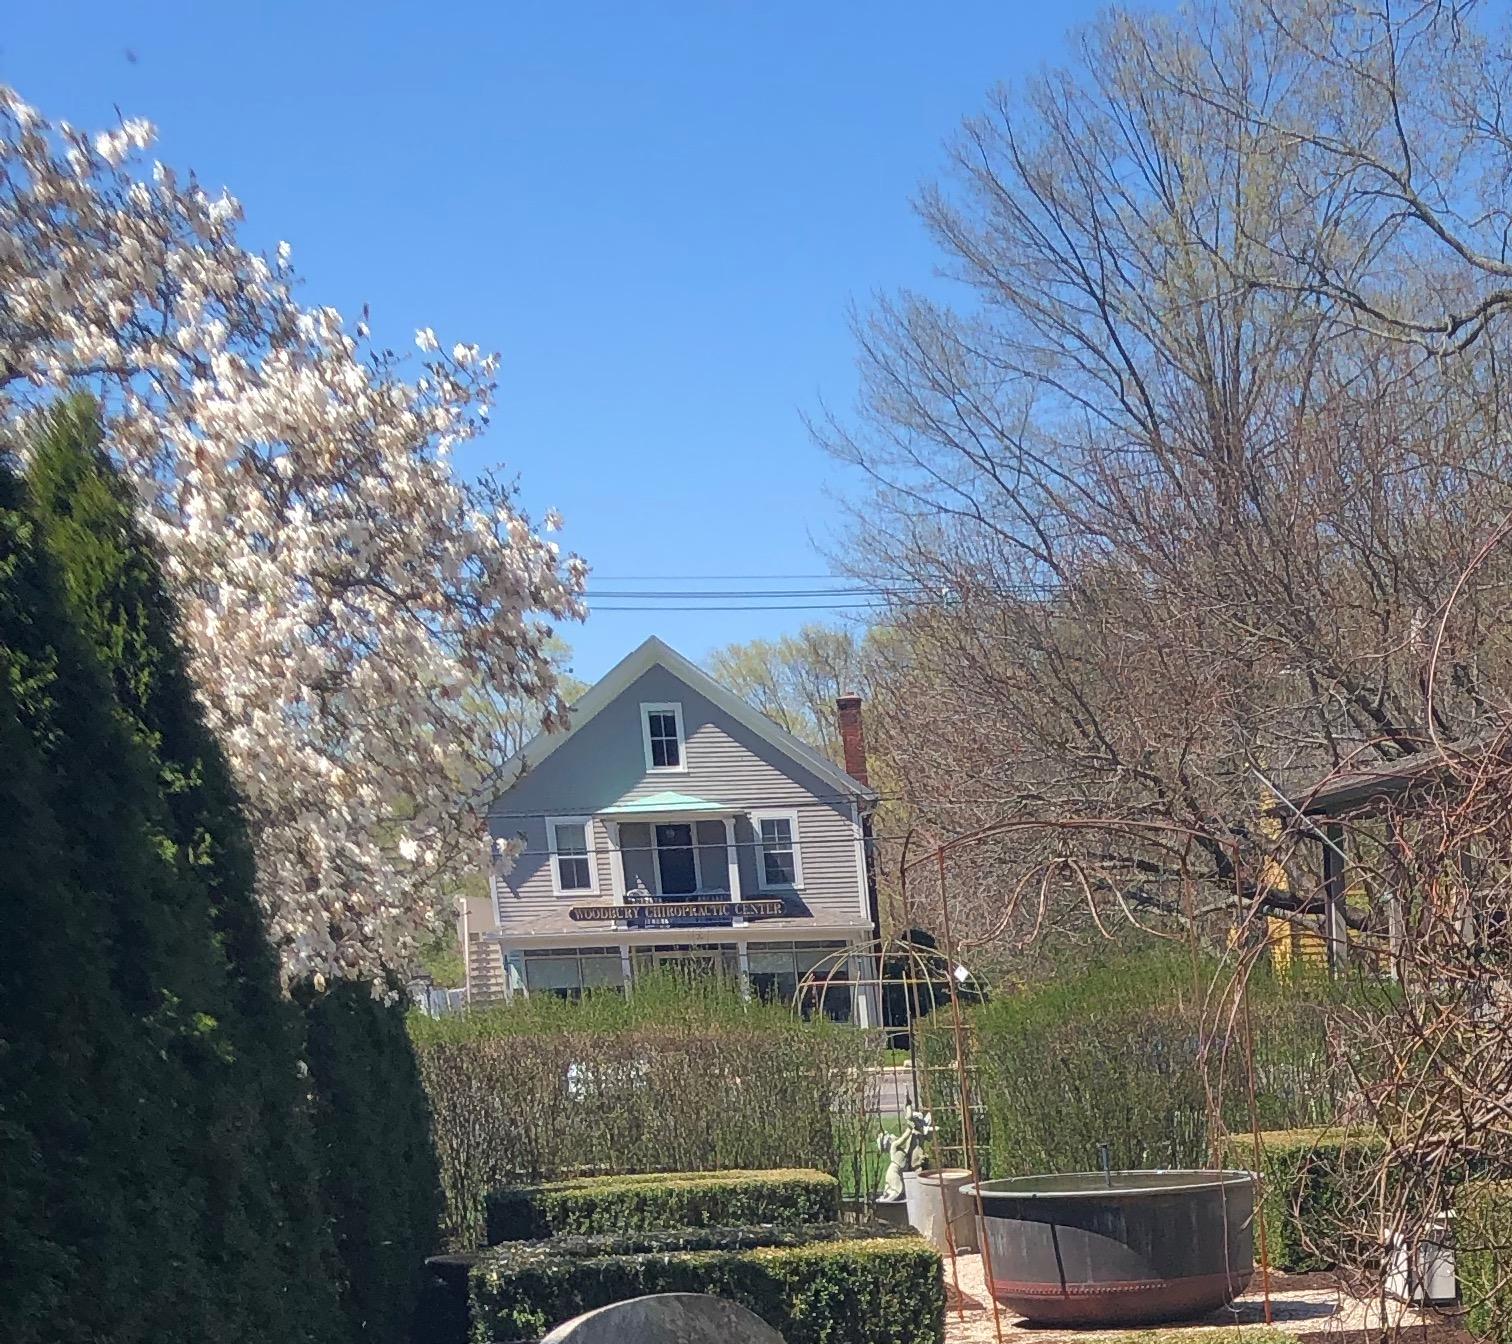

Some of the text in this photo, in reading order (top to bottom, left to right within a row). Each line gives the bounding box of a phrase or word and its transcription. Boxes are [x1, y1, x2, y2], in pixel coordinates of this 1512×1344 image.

[574, 902, 782, 920] WOODBURY CHIROPRACTIC CENTER
